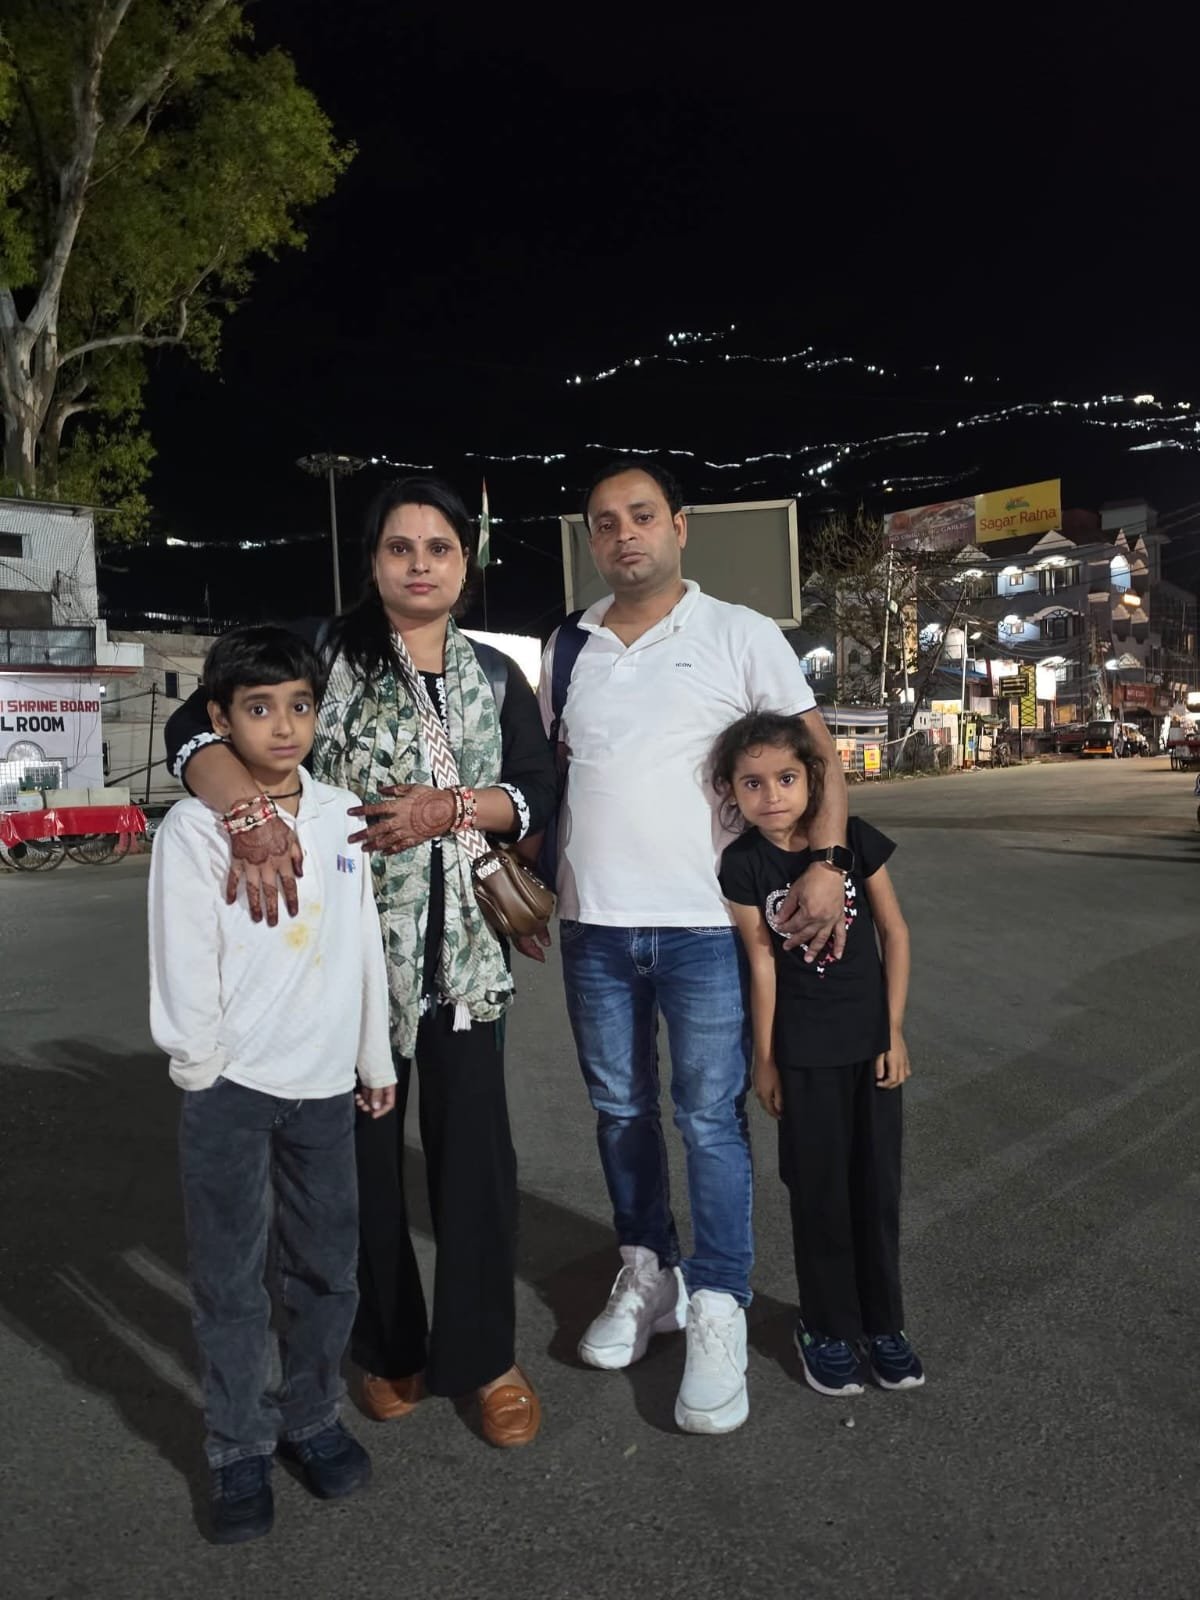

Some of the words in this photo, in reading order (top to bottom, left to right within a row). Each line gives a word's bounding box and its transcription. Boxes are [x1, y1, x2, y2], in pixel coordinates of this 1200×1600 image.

[980, 514, 1017, 531] Sagar
[1020, 508, 1057, 524] Ratna
[7, 700, 58, 712] SHRINE
[60, 700, 100, 712] BOARD
[16, 716, 65, 732] ROOM
